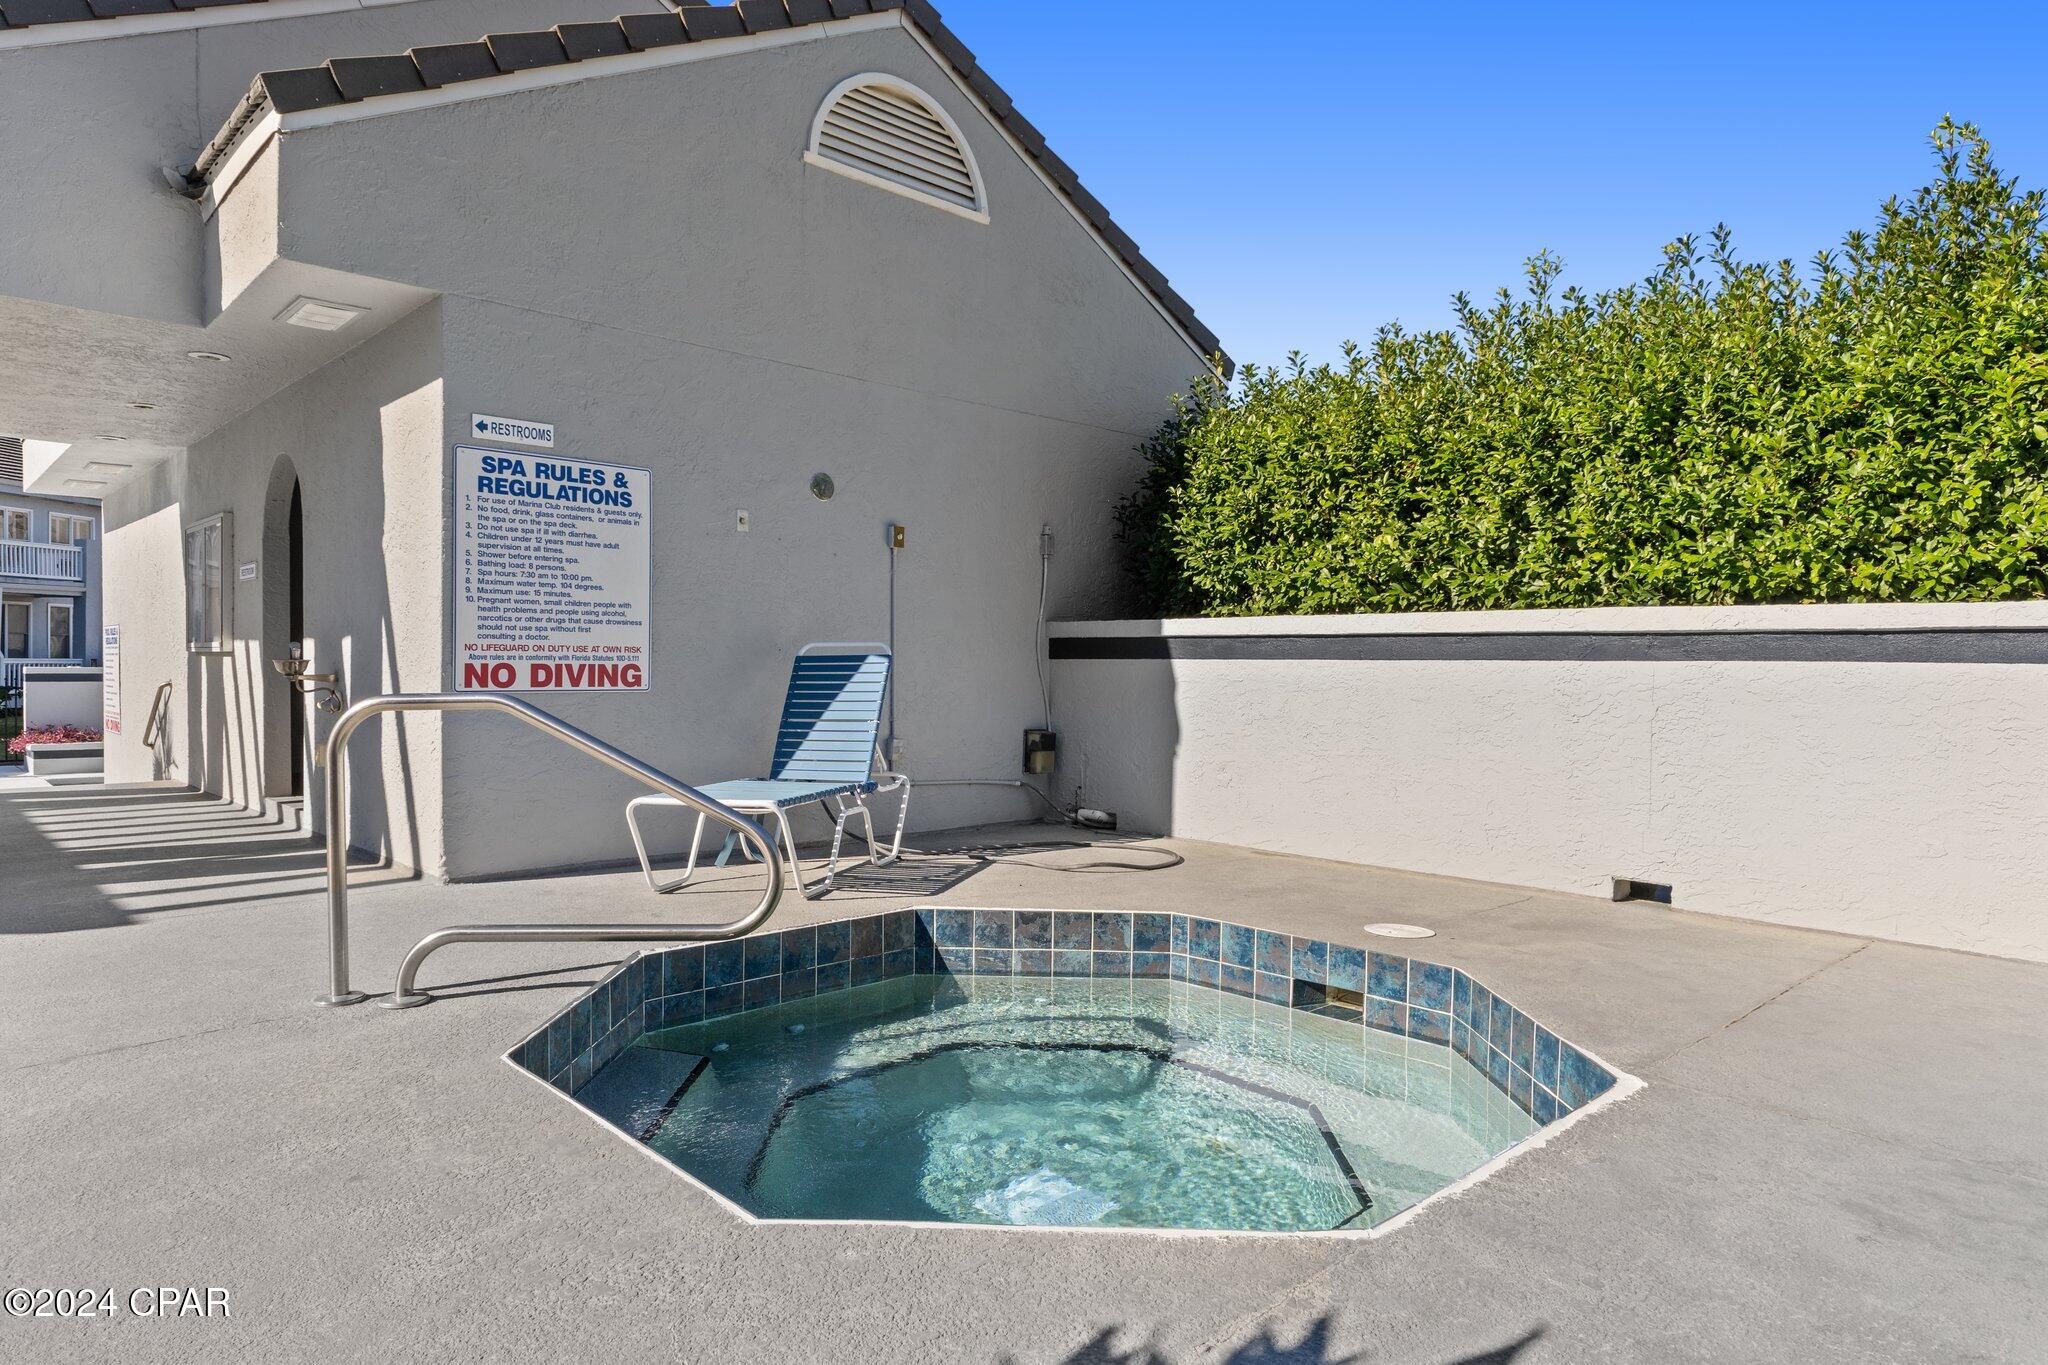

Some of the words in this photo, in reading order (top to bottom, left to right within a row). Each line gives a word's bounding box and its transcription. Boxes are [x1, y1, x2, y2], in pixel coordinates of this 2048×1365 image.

[491, 422, 551, 441] RESTROOMS
[482, 456, 526, 477] SPA
[536, 463, 605, 485] RULES
[614, 472, 628, 489] &
[478, 476, 632, 507] REGULATIONS
[491, 506, 510, 514] food,
[518, 500, 542, 508] Marina
[563, 505, 594, 513] residents
[478, 532, 508, 540] Children
[568, 531, 597, 539] diarrhea.
[478, 542, 521, 550] supervision
[534, 555, 563, 564] entering
[478, 560, 506, 569] Bathing
[478, 578, 514, 586] Maximum
[477, 596, 511, 604] Pregnant
[546, 617, 566, 625] drugs
[478, 633, 516, 641] consulting
[464, 663, 517, 688] NO
[530, 663, 641, 688] DIVING
